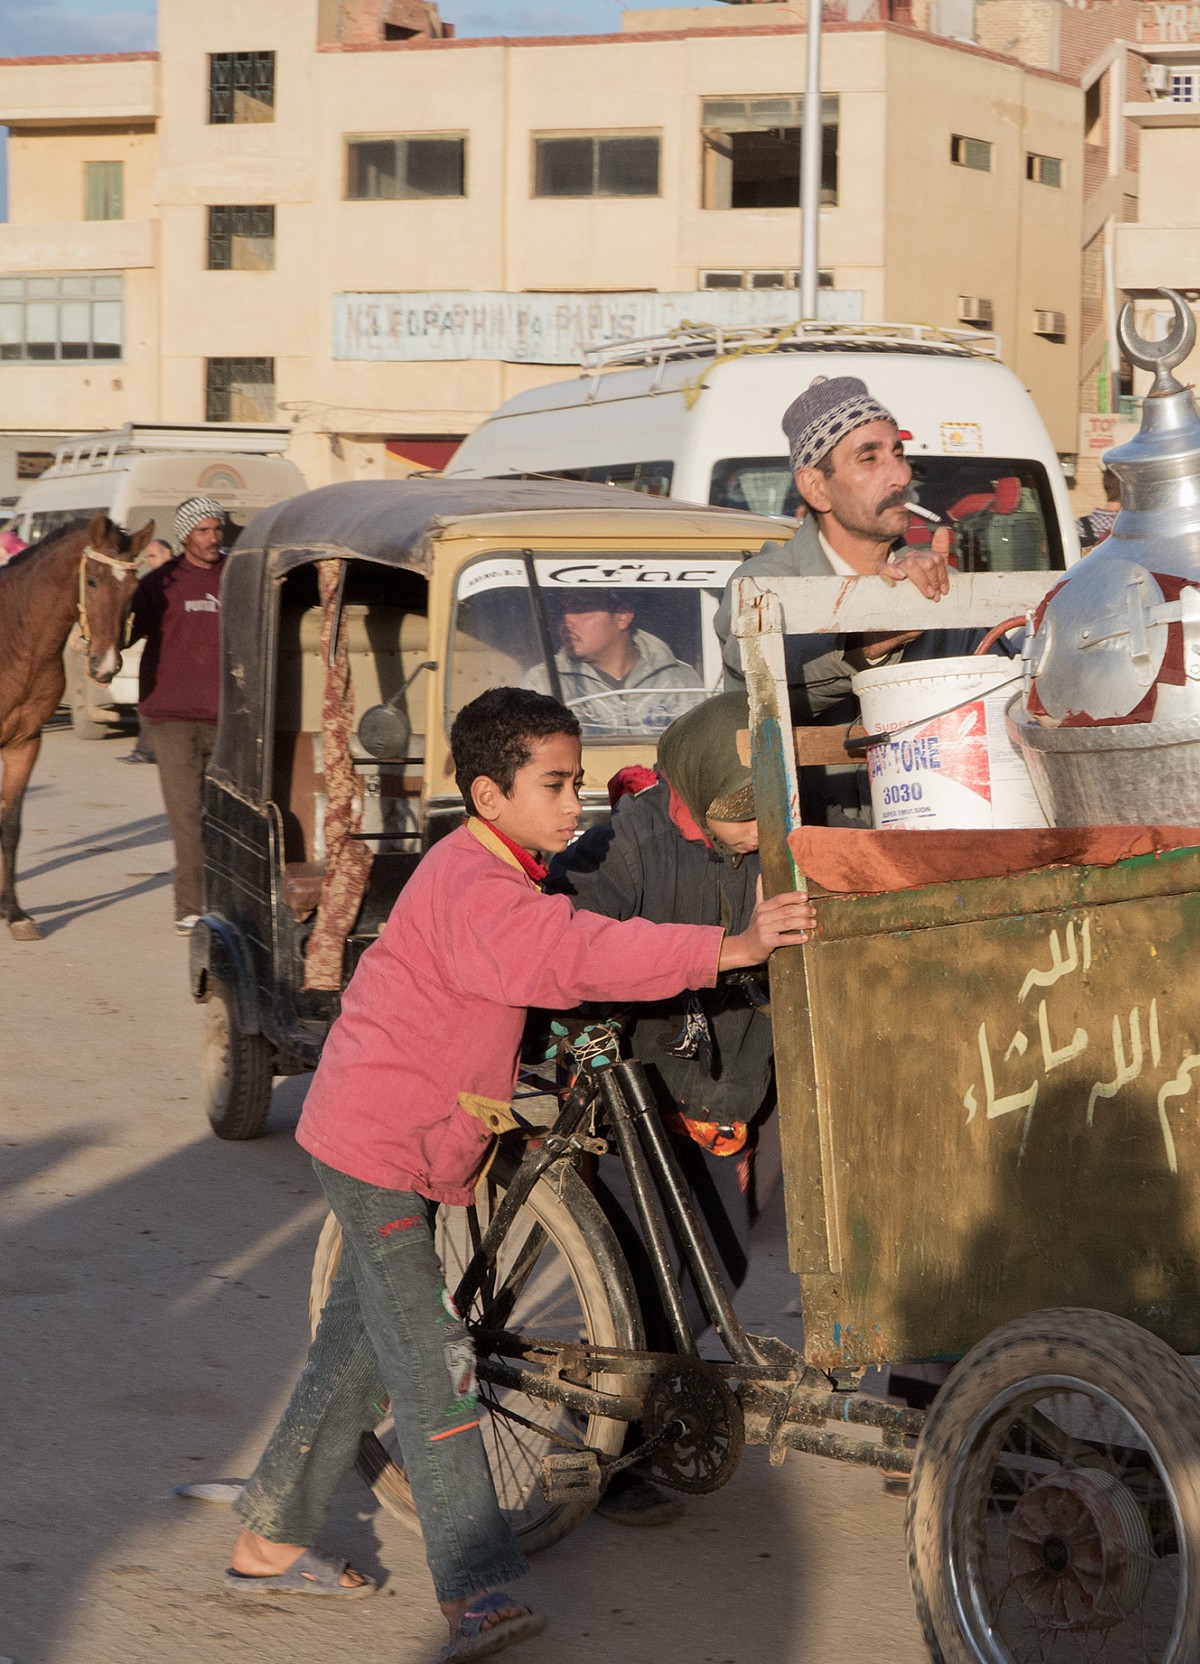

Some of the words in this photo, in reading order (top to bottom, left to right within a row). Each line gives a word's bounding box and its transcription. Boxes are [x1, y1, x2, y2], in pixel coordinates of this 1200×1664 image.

[882, 782, 923, 805] 3030
[1018, 917, 1092, 1004] الله
[1086, 998, 1162, 1128] الله
